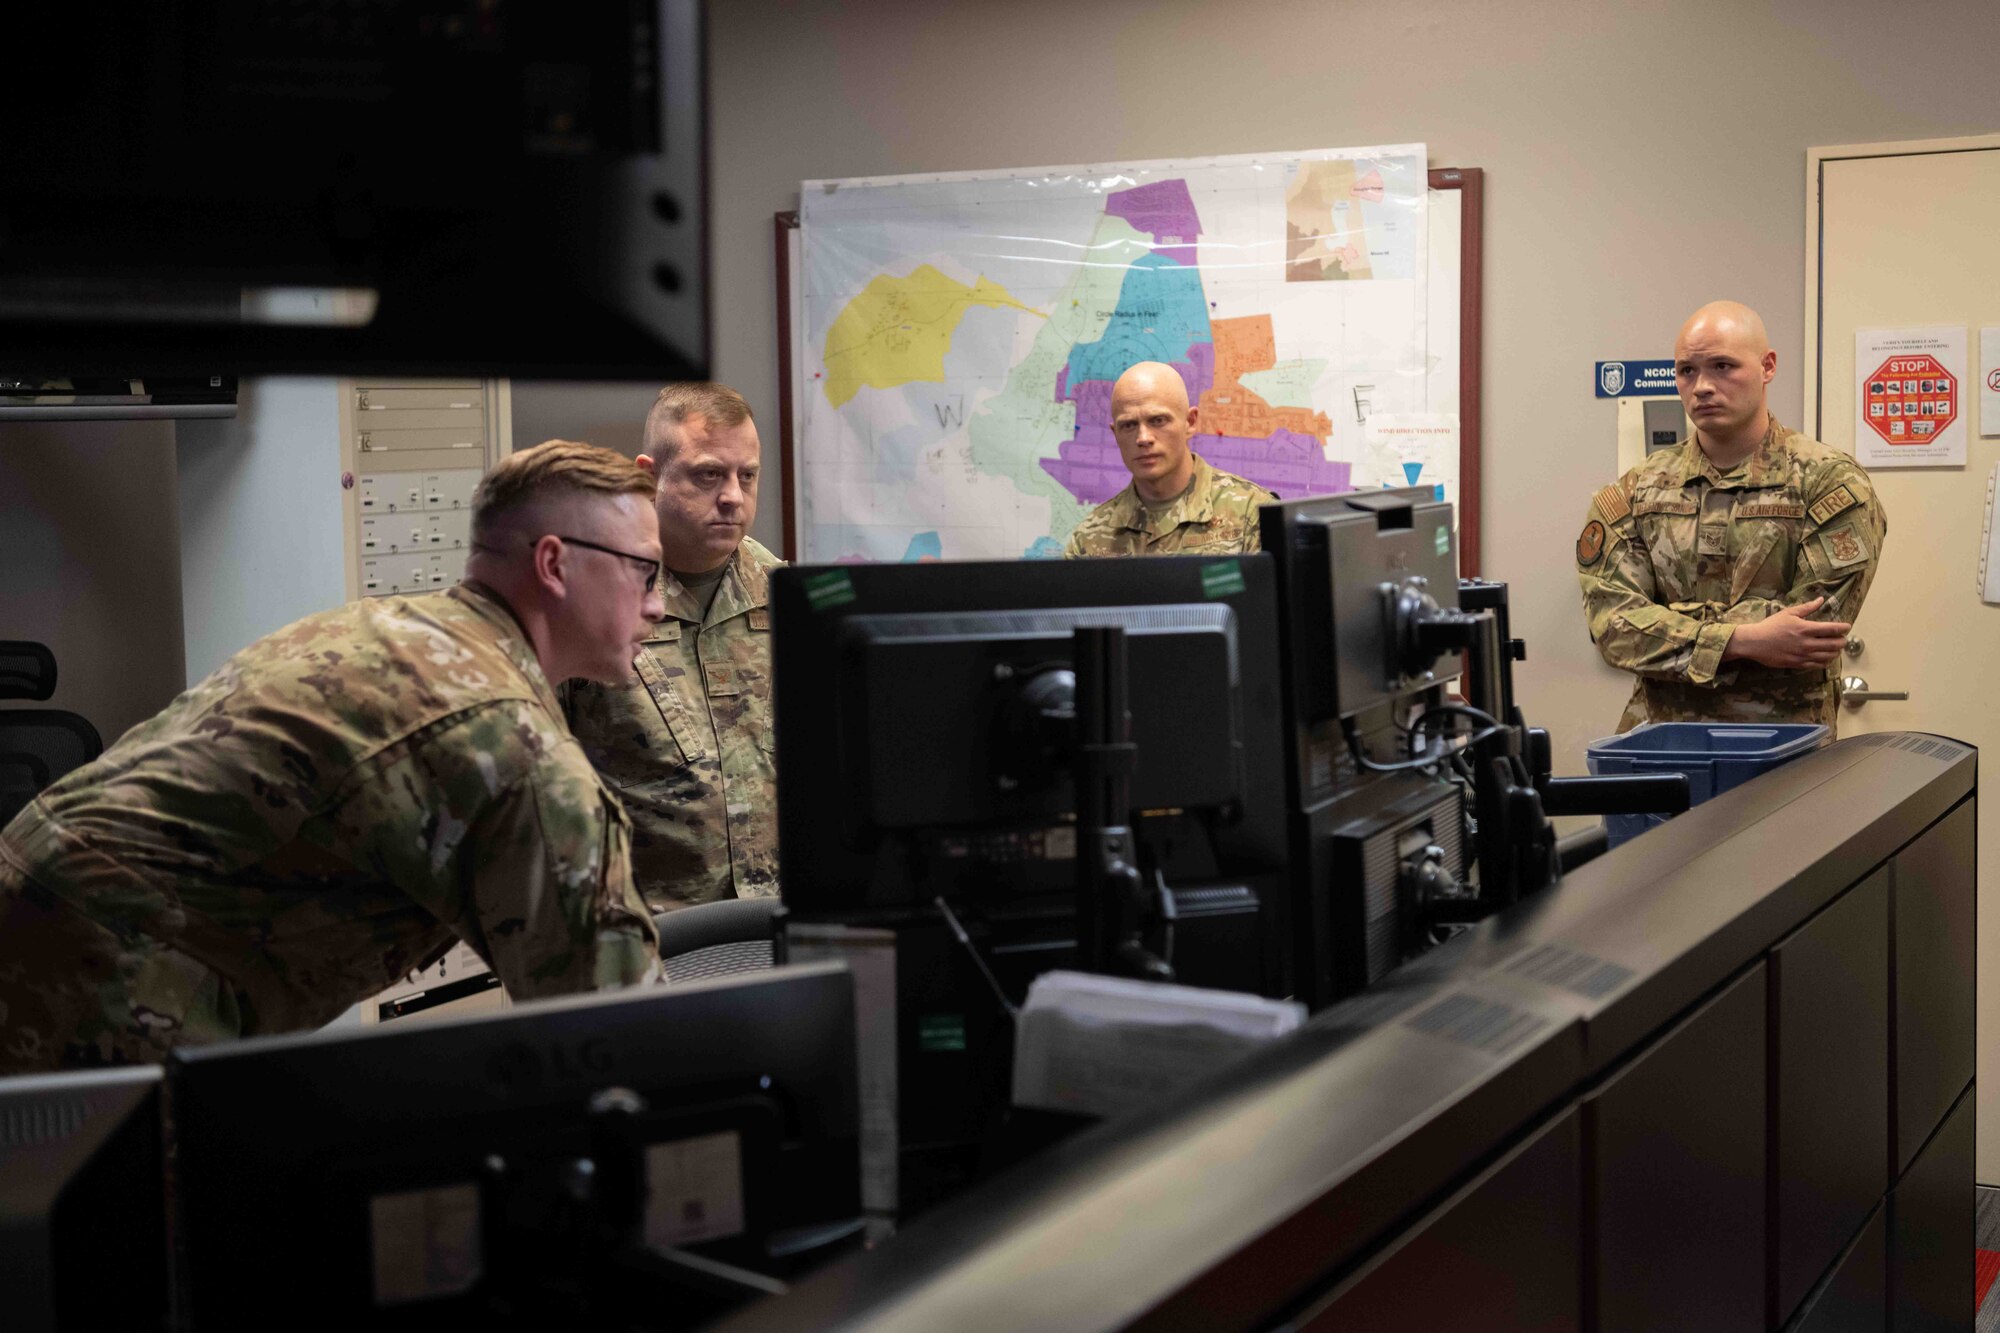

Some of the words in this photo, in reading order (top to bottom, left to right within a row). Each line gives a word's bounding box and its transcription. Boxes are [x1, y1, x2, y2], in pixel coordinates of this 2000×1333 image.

[1095, 310, 1113, 318] Circle
[1114, 310, 1136, 318] Radius
[1890, 360, 1929, 373] STOP!
[1741, 505, 1755, 516] U.S.
[1756, 504, 1770, 516] AIR
[1772, 504, 1801, 516] FORCE
[1811, 488, 1852, 521] FIRE
[554, 1036, 615, 1079] LG
